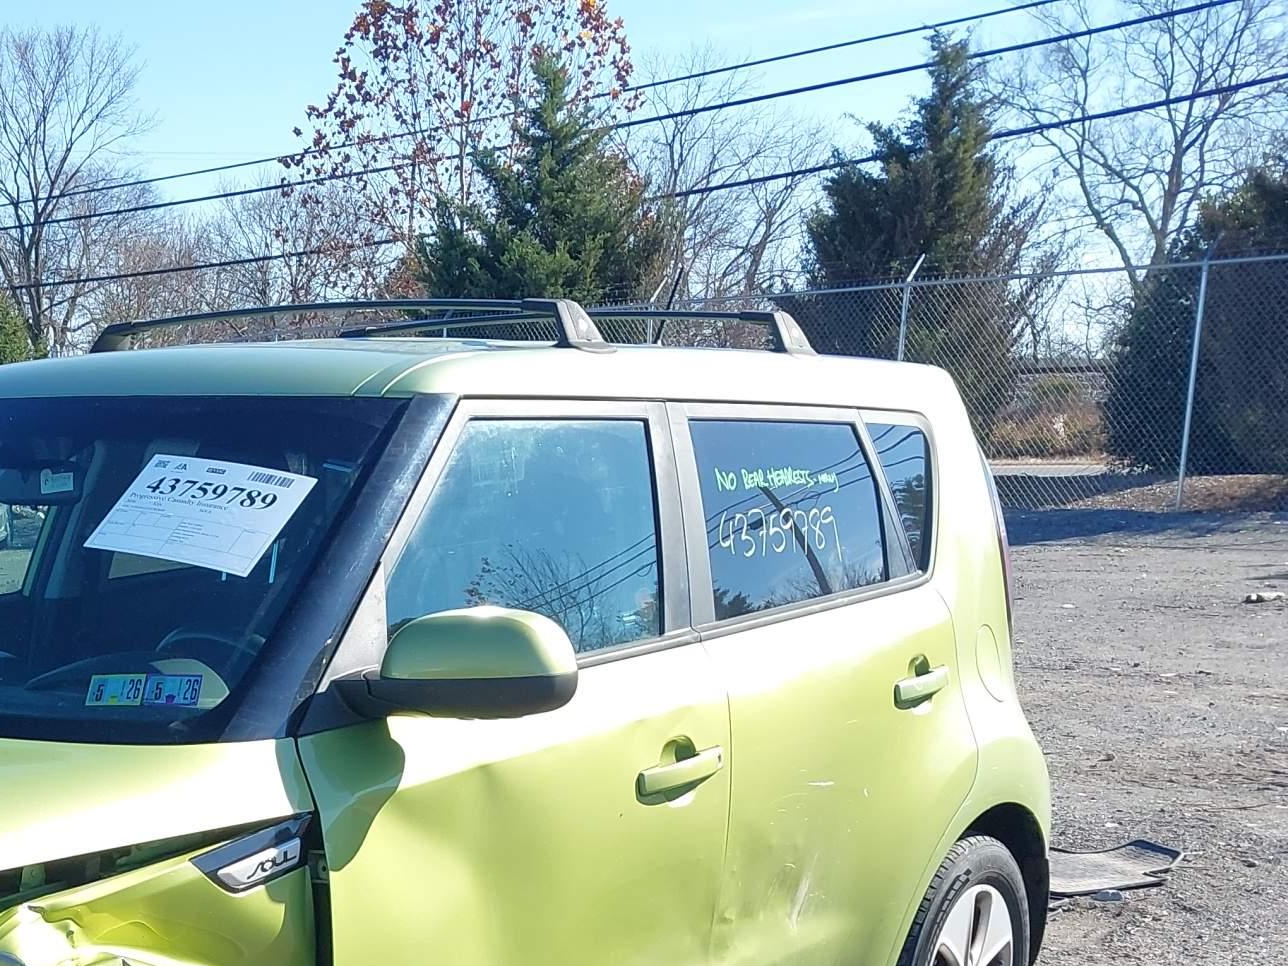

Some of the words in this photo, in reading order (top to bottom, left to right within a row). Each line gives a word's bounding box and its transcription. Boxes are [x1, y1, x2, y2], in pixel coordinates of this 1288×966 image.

[146, 476, 278, 510] 43759789
[714, 467, 737, 491] NO
[719, 505, 843, 561] 43759789
